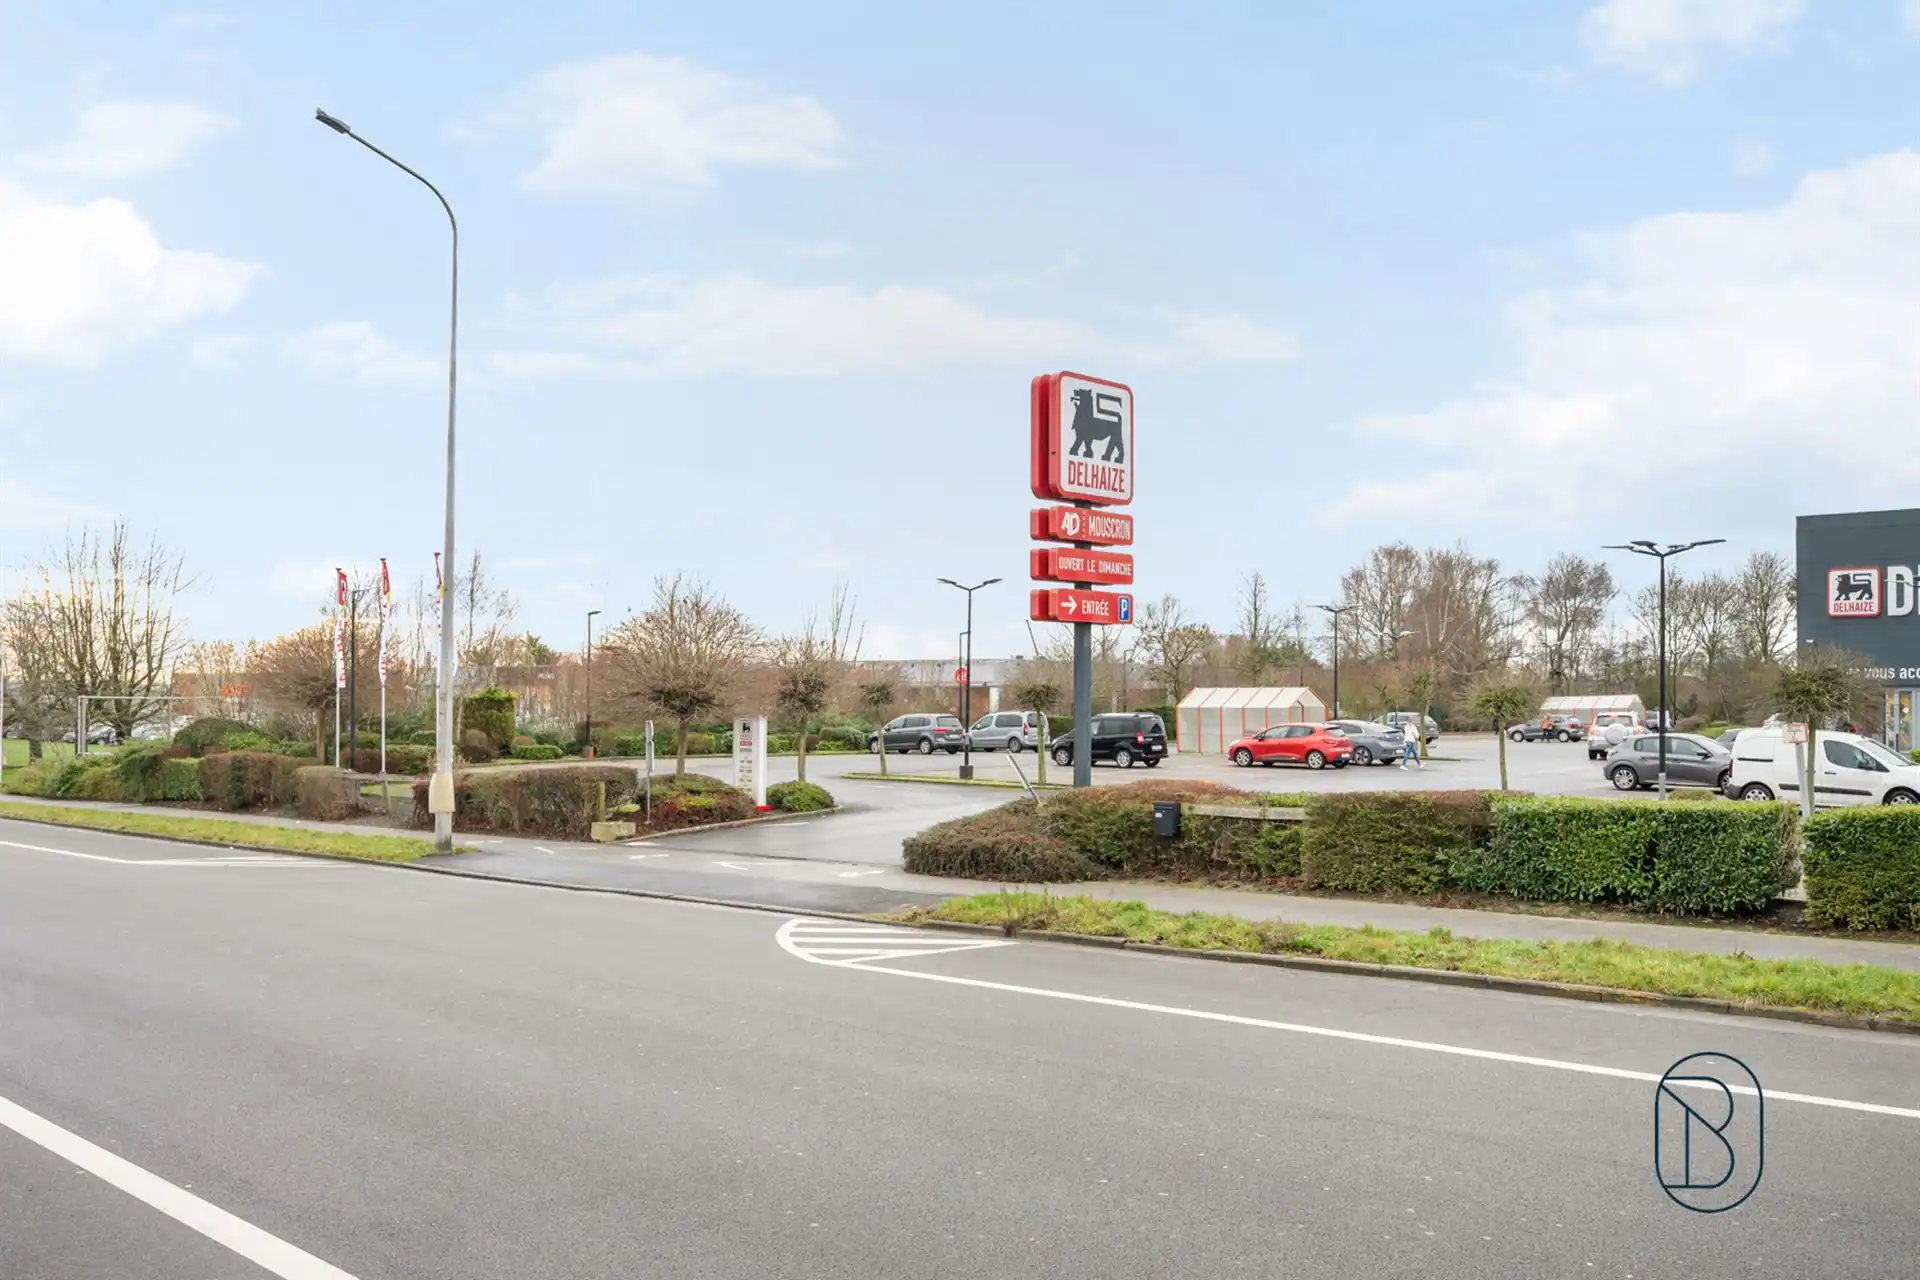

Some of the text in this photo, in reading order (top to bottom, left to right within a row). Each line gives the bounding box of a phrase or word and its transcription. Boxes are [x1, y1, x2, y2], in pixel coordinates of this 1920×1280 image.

[1068, 460, 1125, 493] DELHAIZE
[1061, 511, 1131, 540] AD MOUSCRON
[1059, 556, 1132, 576] OUVERT LE DIMANCHE
[1887, 564, 1920, 616] D
[1082, 599, 1109, 616] ENTRÉE
[1833, 601, 1874, 613] DELHAIZE
